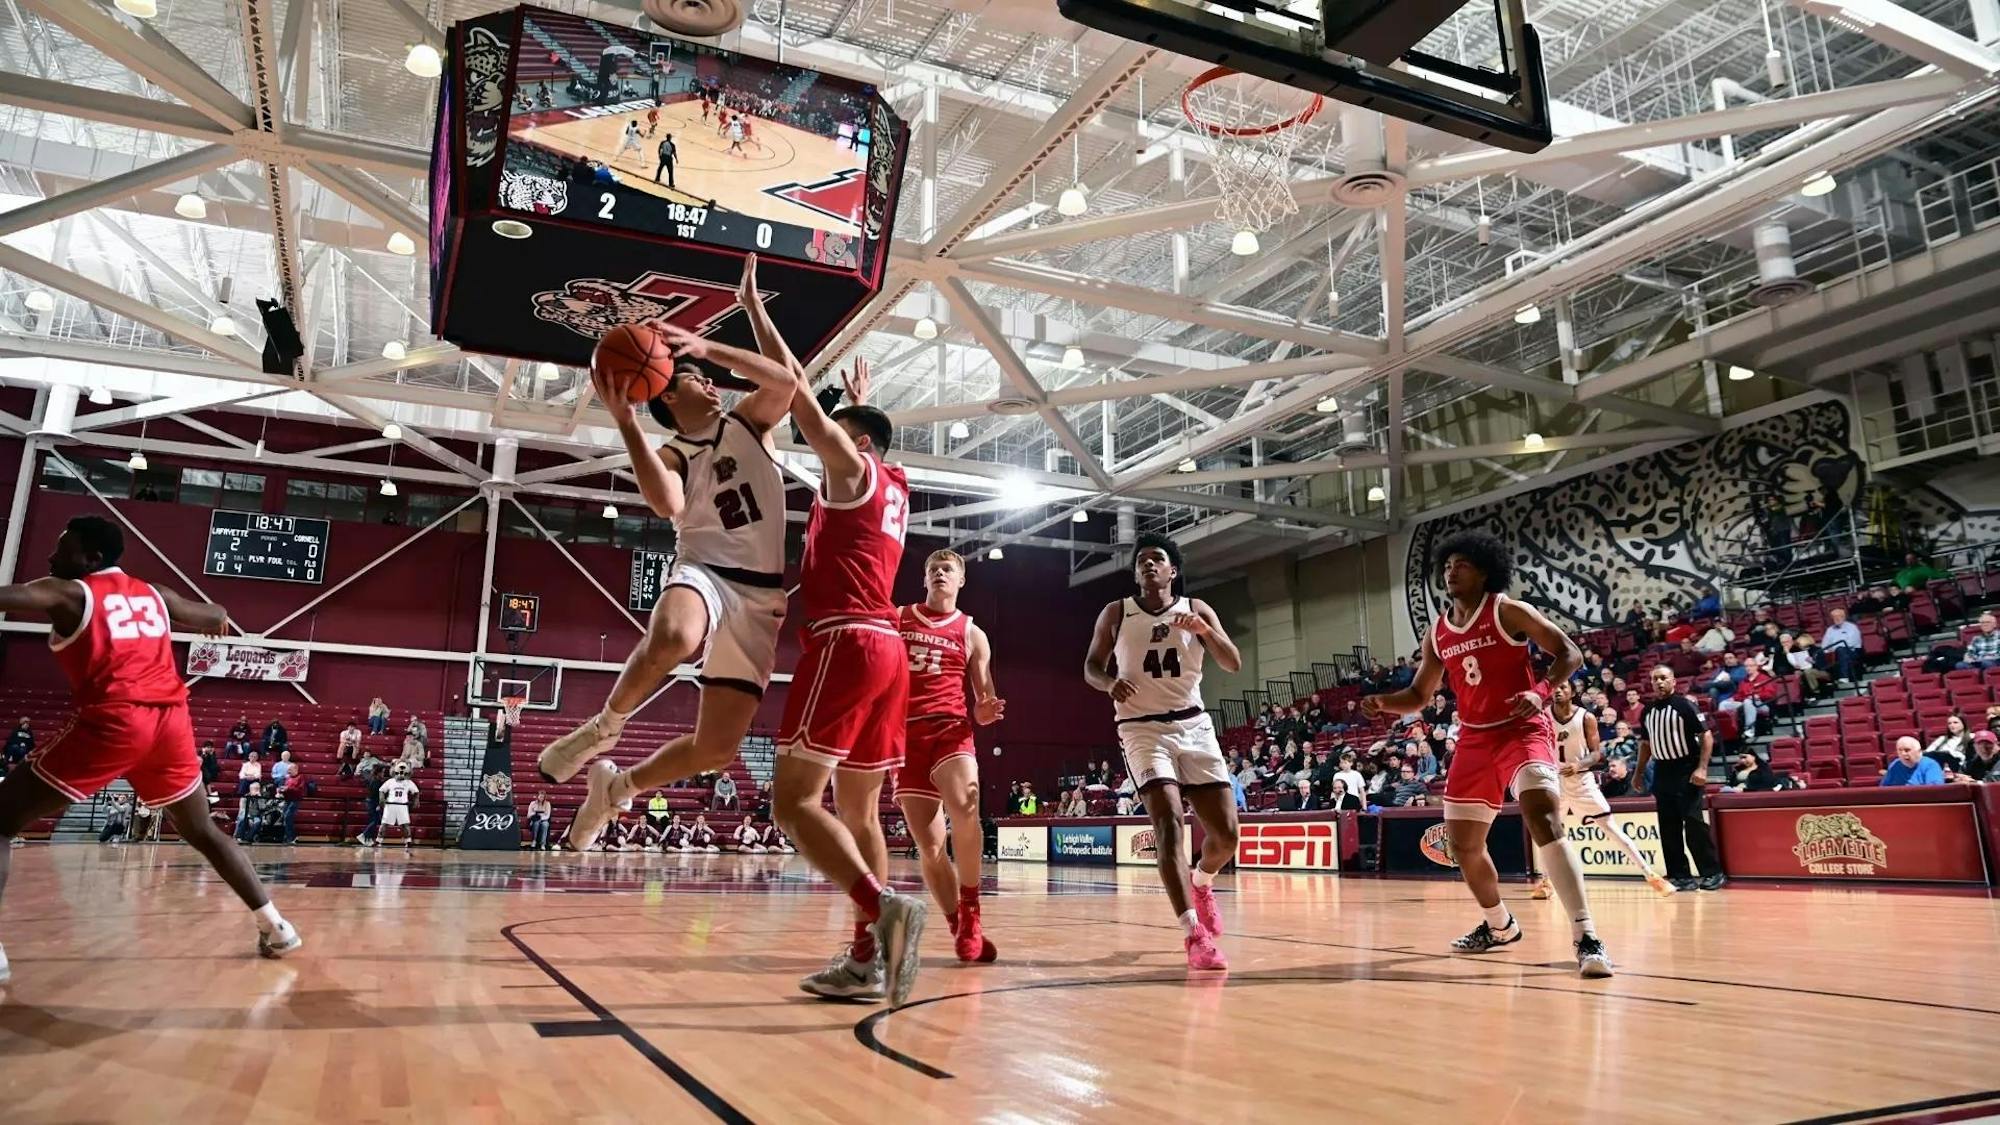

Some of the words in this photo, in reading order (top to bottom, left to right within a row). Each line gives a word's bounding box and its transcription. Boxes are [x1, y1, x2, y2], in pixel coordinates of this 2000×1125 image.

[598, 192, 617, 220] 2
[667, 203, 708, 226] 18:47
[676, 224, 697, 239] 1ST
[756, 223, 772, 249] 0
[713, 482, 763, 530] 21
[255, 515, 293, 532] 18:47
[212, 527, 249, 538] LAFAYETTE
[294, 534, 320, 544] CORNELL
[230, 537, 241, 551] 2
[267, 543, 272, 552] 1
[308, 544, 318, 559] 0
[213, 552, 227, 561] FLS
[249, 555, 265, 563] PLYR
[267, 556, 283, 566] FOUL
[304, 560, 317, 568] FLS
[216, 561, 225, 573] 0
[234, 563, 242, 573] 4
[287, 567, 295, 578] 4
[306, 568, 315, 580] 0
[631, 560, 642, 601] LAFAYETTE
[509, 598, 535, 609] 18:47
[103, 593, 168, 639] 23
[520, 610, 531, 627] 7
[900, 631, 960, 651] CORNELL
[1441, 635, 1497, 660] CORNELL
[226, 645, 278, 665] Leopards
[908, 645, 943, 675] 31
[1143, 647, 1181, 678] 44
[225, 664, 270, 680] Lair
[1462, 655, 1482, 686] 8
[1063, 833, 1079, 844] Lehigh
[1080, 834, 1095, 846] Valley
[1564, 826, 1607, 841] ASTO
[1623, 822, 1660, 840] COA
[1063, 844, 1090, 857] Orthopedic
[1091, 846, 1113, 856] Institute
[1239, 825, 1332, 867] ESPN
[1801, 837, 1886, 866] LAFAYETTE
[1808, 863, 1845, 874] COLLEGE
[1846, 864, 1875, 875] STORE
